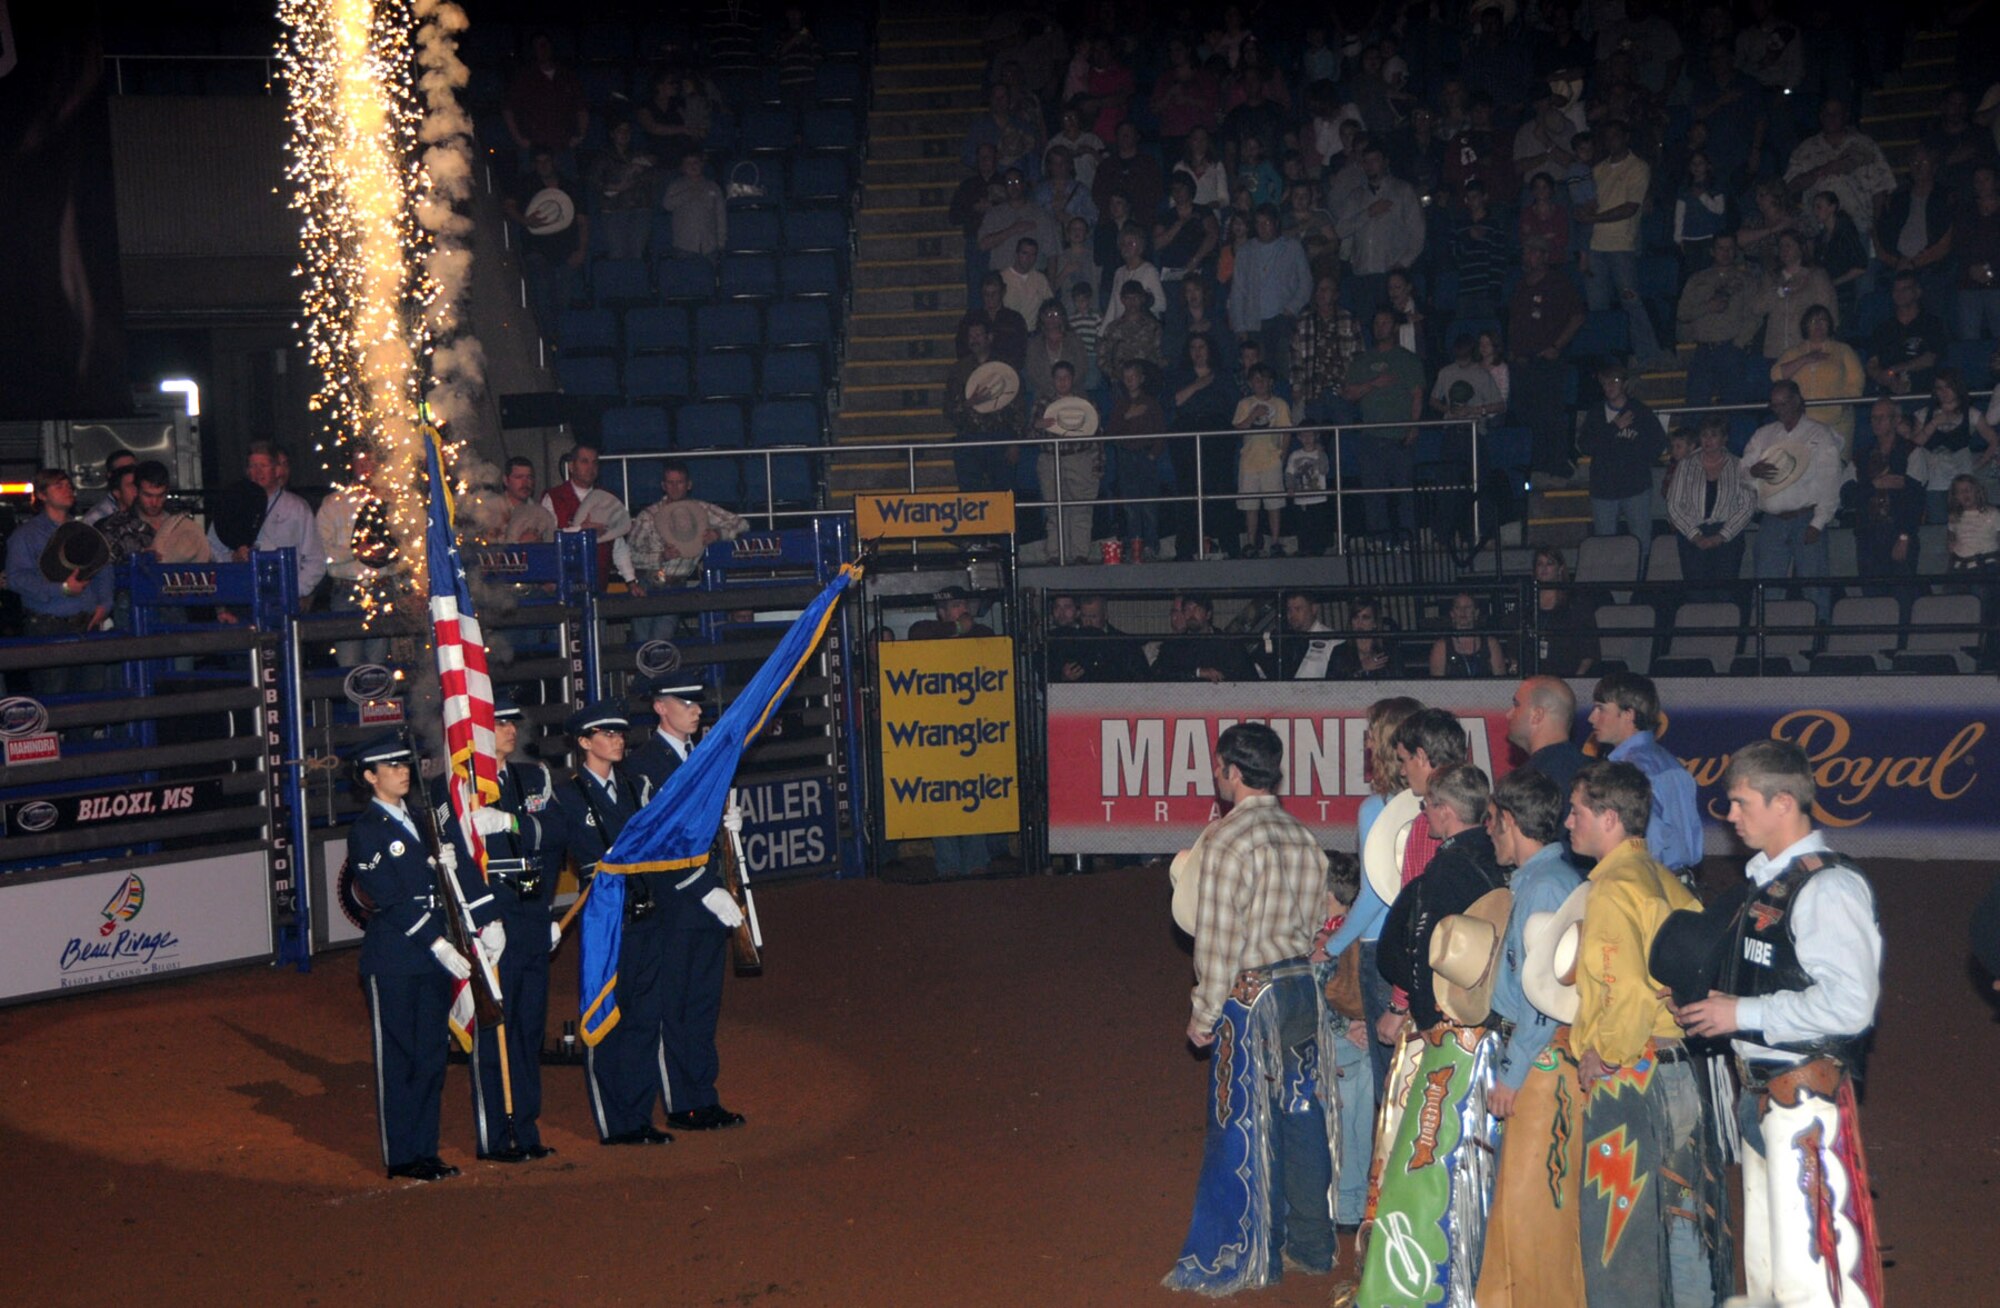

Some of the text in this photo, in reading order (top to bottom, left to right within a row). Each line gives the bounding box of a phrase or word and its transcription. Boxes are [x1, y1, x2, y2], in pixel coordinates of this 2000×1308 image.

[875, 497, 989, 533] Wrangler
[570, 640, 585, 711] CBRb
[885, 666, 1008, 705] Wrangler
[829, 628, 848, 810] BRbull.com
[887, 718, 1010, 757] Wrangler
[10, 738, 56, 755] MAHINDRA
[263, 668, 288, 891] CBRbull.com
[1771, 709, 1987, 827] Royal
[76, 791, 156, 821] BILOXI,
[161, 786, 194, 810] MS
[738, 780, 822, 824] AILER
[890, 773, 1013, 812] Wrangler
[742, 826, 825, 872] CHES
[60, 929, 178, 970] Beau Rivage
[1744, 936, 1773, 967] VIBE
